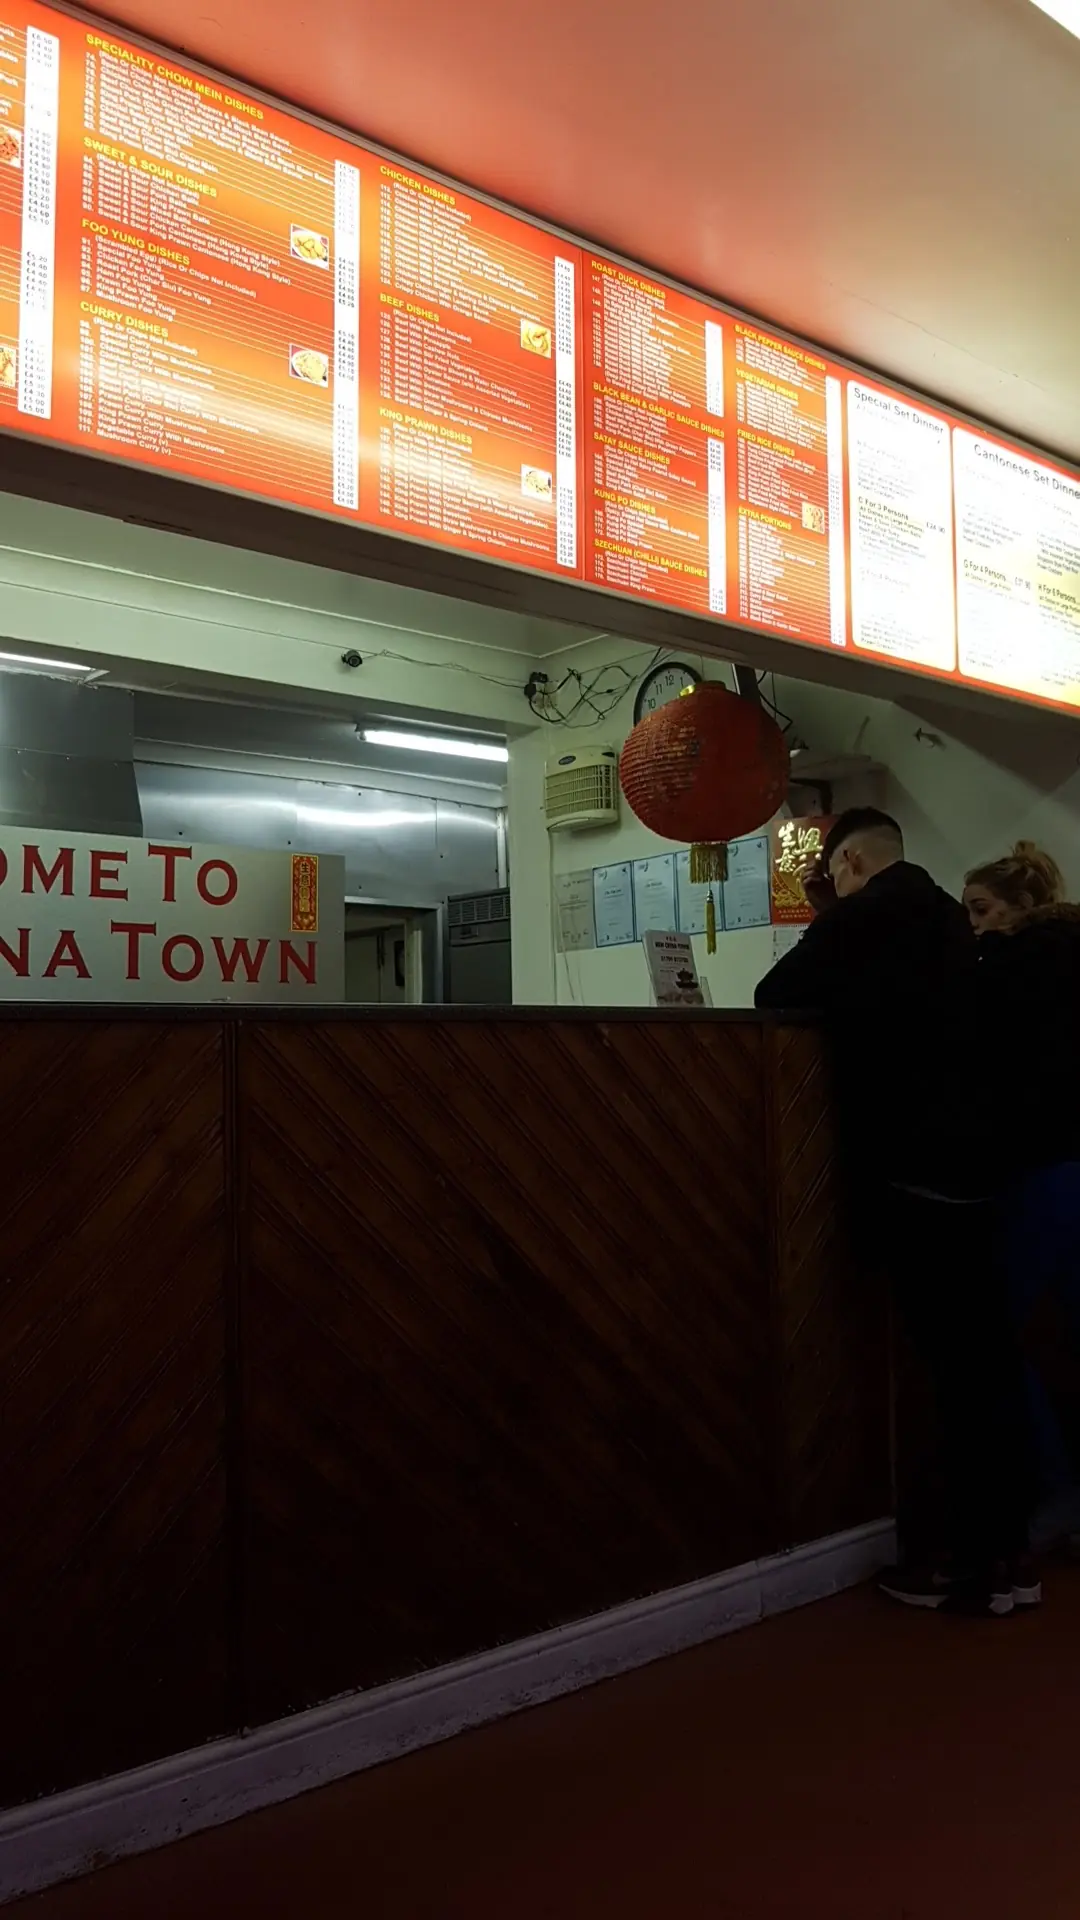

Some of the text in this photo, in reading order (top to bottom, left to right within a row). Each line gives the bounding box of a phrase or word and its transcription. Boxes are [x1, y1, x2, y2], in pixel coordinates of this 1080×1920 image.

[86, 32, 263, 120] SPECIALITY CHOW MEIN DISHES
[83, 135, 216, 198] SWEET & SOUR DISHES
[380, 164, 455, 207] CHICKEN DISHES
[81, 217, 189, 266] FOO YUNG DISHES
[591, 259, 665, 300] ROAST DUCK DISHES
[80, 300, 168, 338] CURRY DISHES
[380, 292, 439, 324] BEEF DISHES
[734, 323, 825, 371] BLACK PEPPER SAUCE DISHES
[735, 367, 798, 401] VEGETARIAN DISHES
[380, 406, 472, 445] KING PRAWN DISHES
[593, 382, 724, 438] BLACK BEAN & GARLIC SAUCE DISHES
[854, 385, 890, 415] Special
[894, 404, 909, 421] Set
[912, 411, 943, 437] Dinner
[96, 428, 137, 446] Mushroom
[139, 440, 160, 453] Curry
[161, 446, 171, 456] (v)
[593, 431, 670, 465] SATAY SAUCE DISHES
[737, 428, 795, 457] FRIED RICE DISHES
[974, 441, 1030, 480] Cantonese
[1033, 468, 1049, 487] Set
[594, 487, 655, 514] KUNG PO DISHES
[738, 505, 791, 531] EXTRA PORTIONS
[865, 497, 875, 508] For
[883, 504, 908, 521] Persons
[594, 538, 707, 578] SZECHUAN (CHILLI) SAUCE DISHES
[963, 558, 968, 568] G
[969, 560, 979, 572] For
[984, 566, 1006, 582] Persons
[1043, 584, 1051, 595] For
[1057, 589, 1076, 604] Persons
[656, 684, 662, 695] 11
[665, 675, 674, 686] 12
[648, 698, 656, 709] 10
[0, 842, 238, 905] ME TO
[110, 919, 318, 984] TOWN
